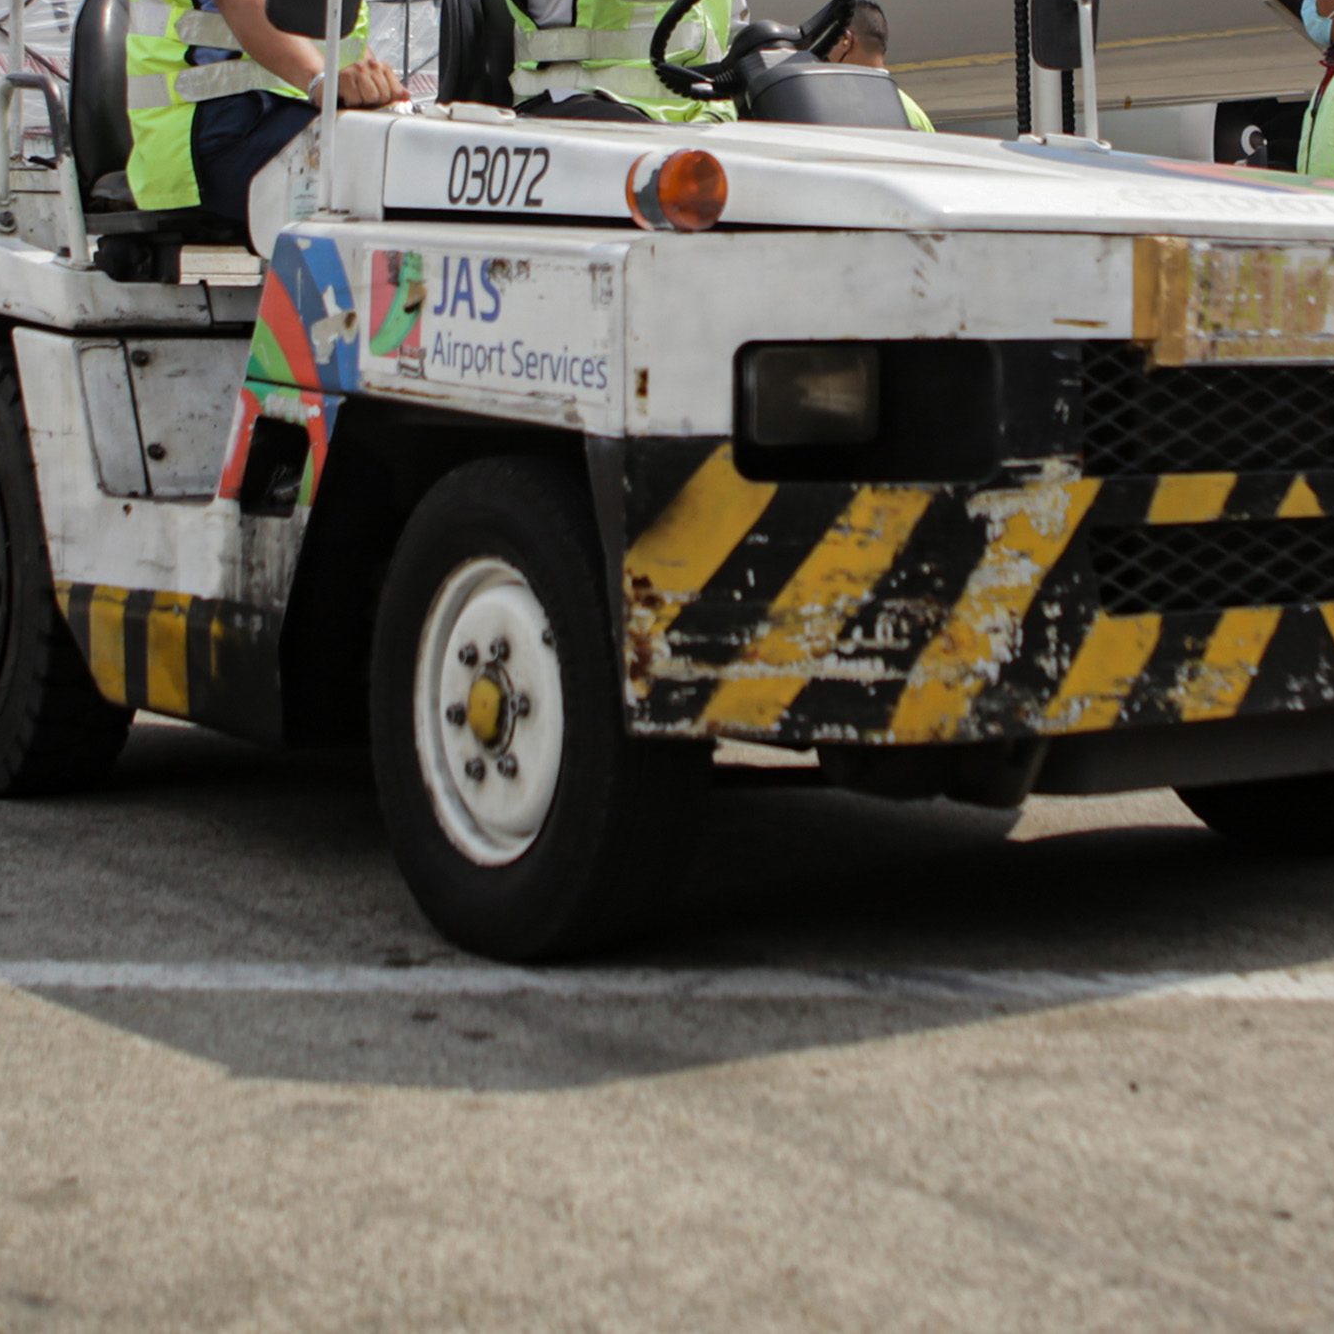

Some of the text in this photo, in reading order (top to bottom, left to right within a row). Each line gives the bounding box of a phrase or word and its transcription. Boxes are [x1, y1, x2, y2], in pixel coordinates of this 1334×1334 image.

[448, 145, 551, 208] 03072
[433, 255, 504, 323] JAS
[432, 331, 608, 391] Airport Services
